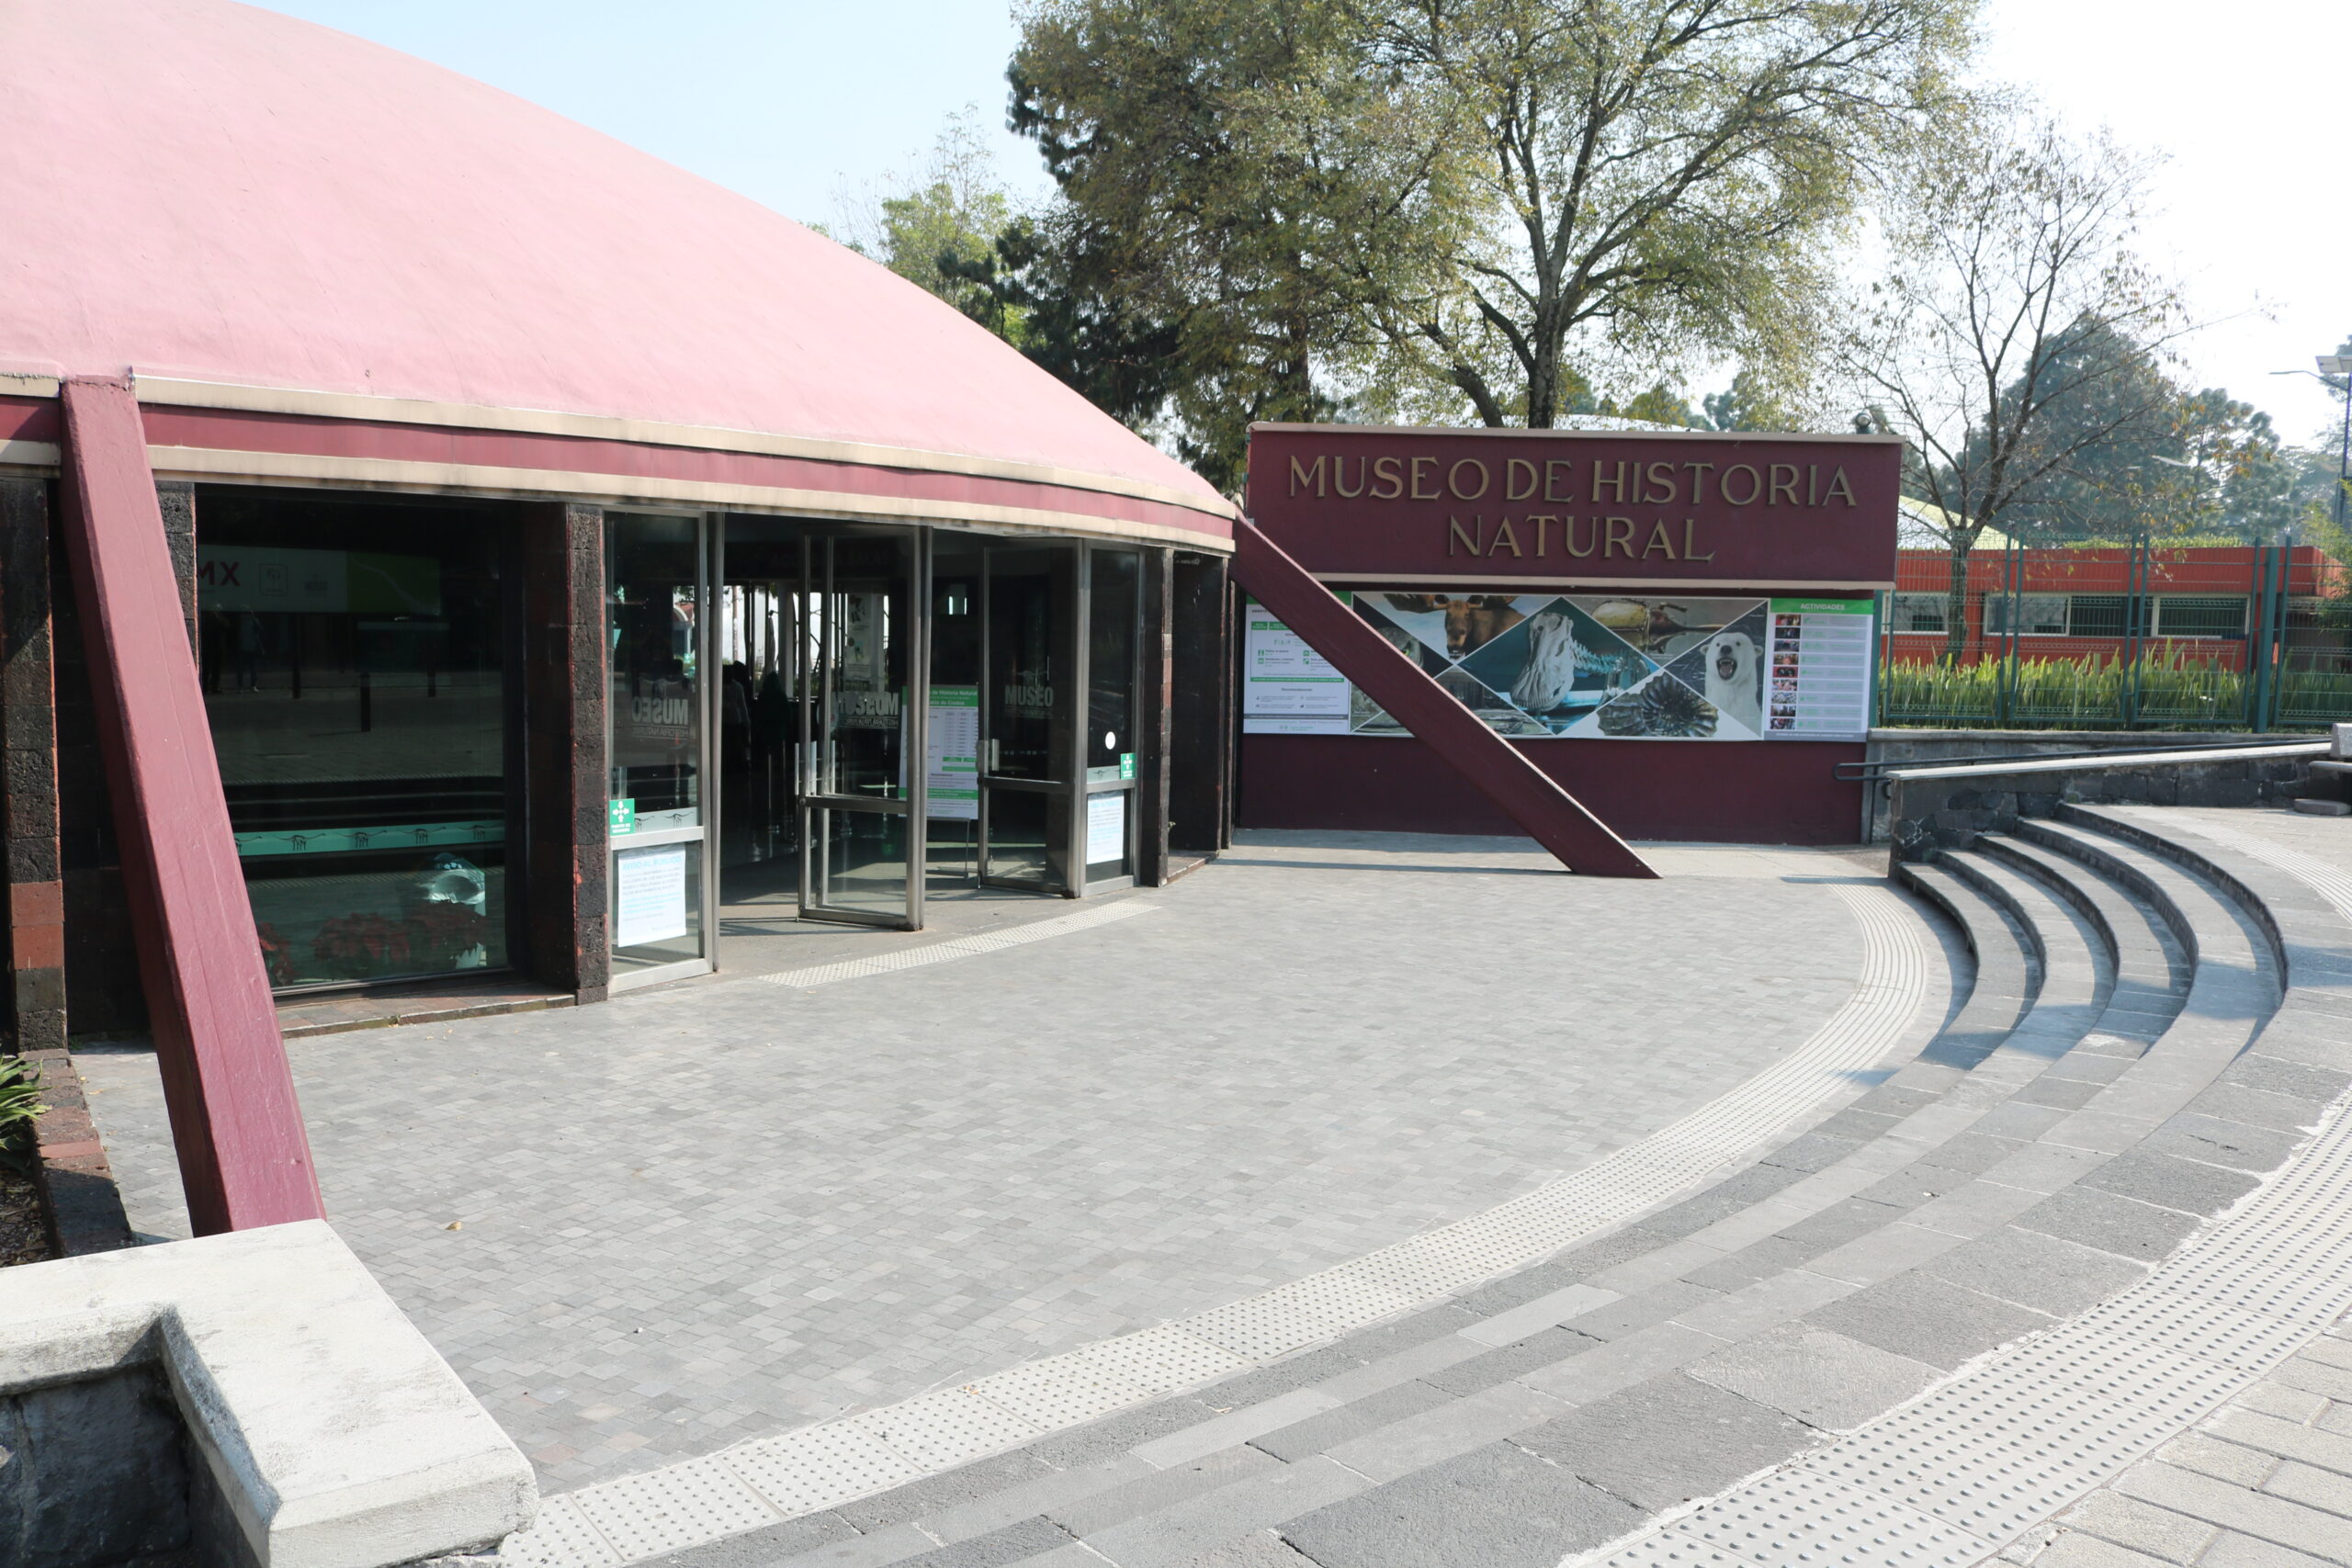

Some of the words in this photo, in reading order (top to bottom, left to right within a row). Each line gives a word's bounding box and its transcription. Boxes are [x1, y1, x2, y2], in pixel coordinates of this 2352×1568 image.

[1290, 456, 1489, 500] MUSEO
[1507, 458, 1575, 502] DE
[1591, 460, 1857, 506] HISTORIA
[1448, 514, 1716, 561] NATURAL
[1800, 603, 1846, 611] ACTIVIDADES
[1005, 685, 1054, 707] MUSEO
